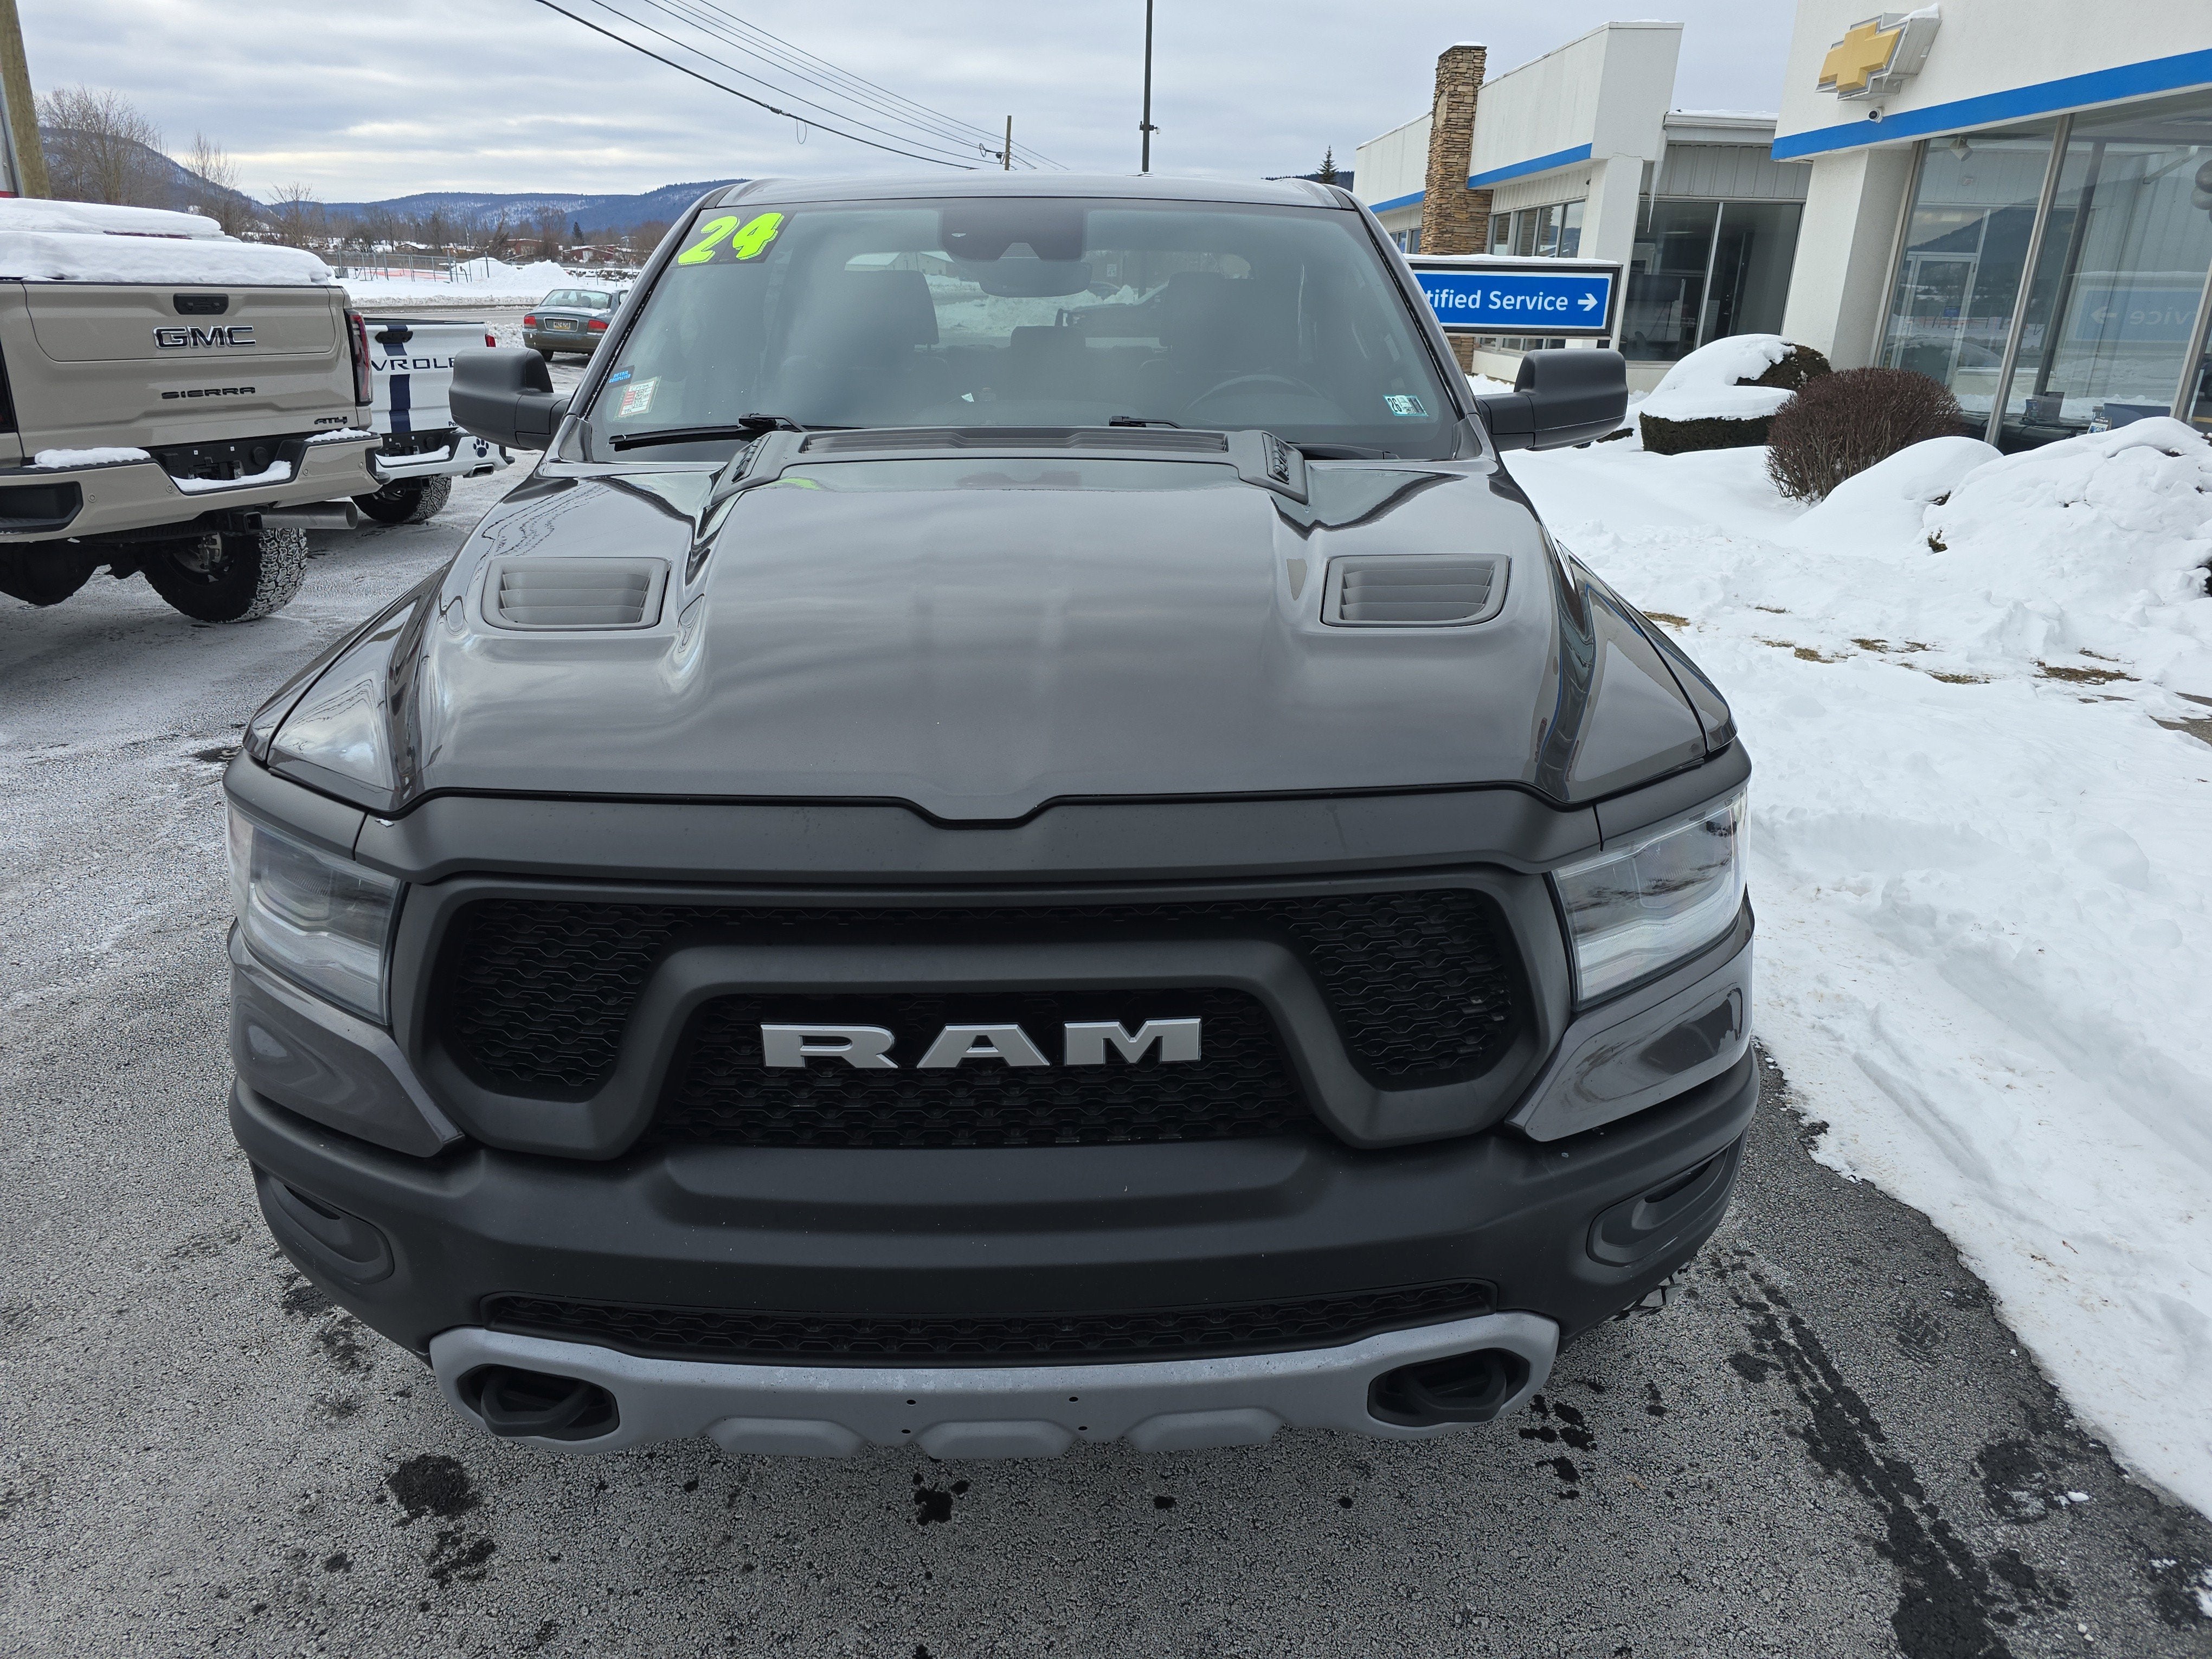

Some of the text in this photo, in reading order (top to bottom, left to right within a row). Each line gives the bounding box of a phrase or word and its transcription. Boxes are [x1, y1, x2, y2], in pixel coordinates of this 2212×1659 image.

[678, 212, 785, 265] 24
[1488, 291, 1568, 311] Service
[153, 325, 256, 349] GMC
[162, 387, 255, 399] SIERRA
[1387, 398, 1402, 412] 26
[314, 416, 348, 425] AT4
[760, 1017, 1201, 1069] RAM
